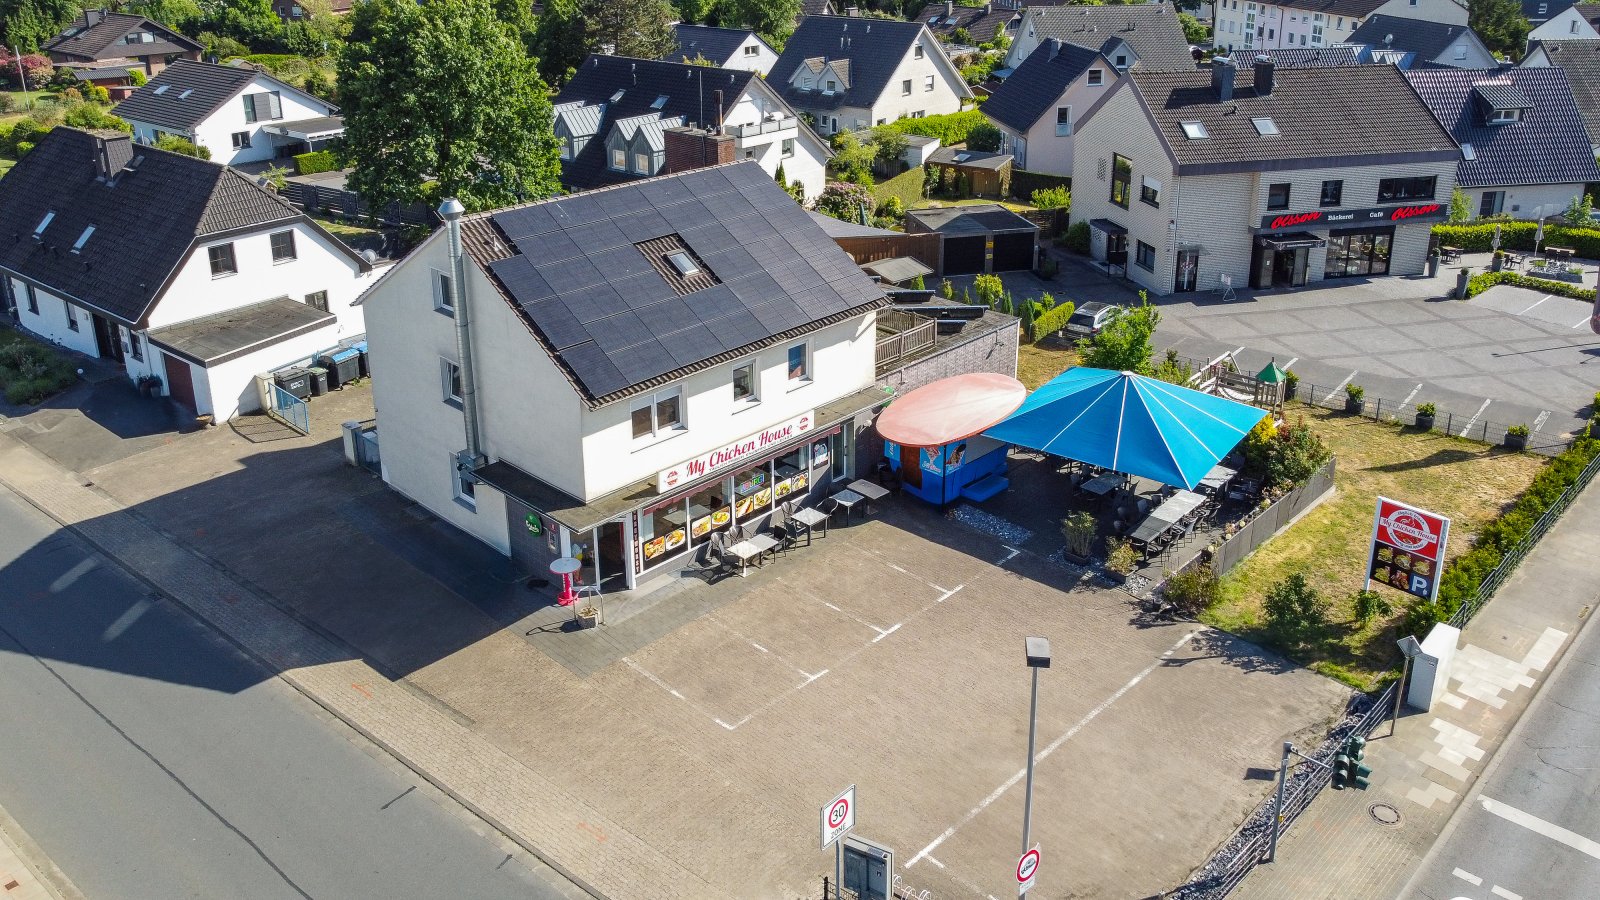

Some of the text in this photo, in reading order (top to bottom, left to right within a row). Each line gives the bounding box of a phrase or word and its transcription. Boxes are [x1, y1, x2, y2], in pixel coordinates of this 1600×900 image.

[1271, 212, 1322, 230] Olsson
[1370, 211, 1384, 219] Café
[1391, 204, 1441, 221] Olsson
[686, 424, 793, 477] My Chicken House
[1383, 519, 1436, 541] My Chicken House
[1411, 575, 1427, 592] P
[832, 805, 844, 822] 30
[831, 823, 846, 839] ZONE
